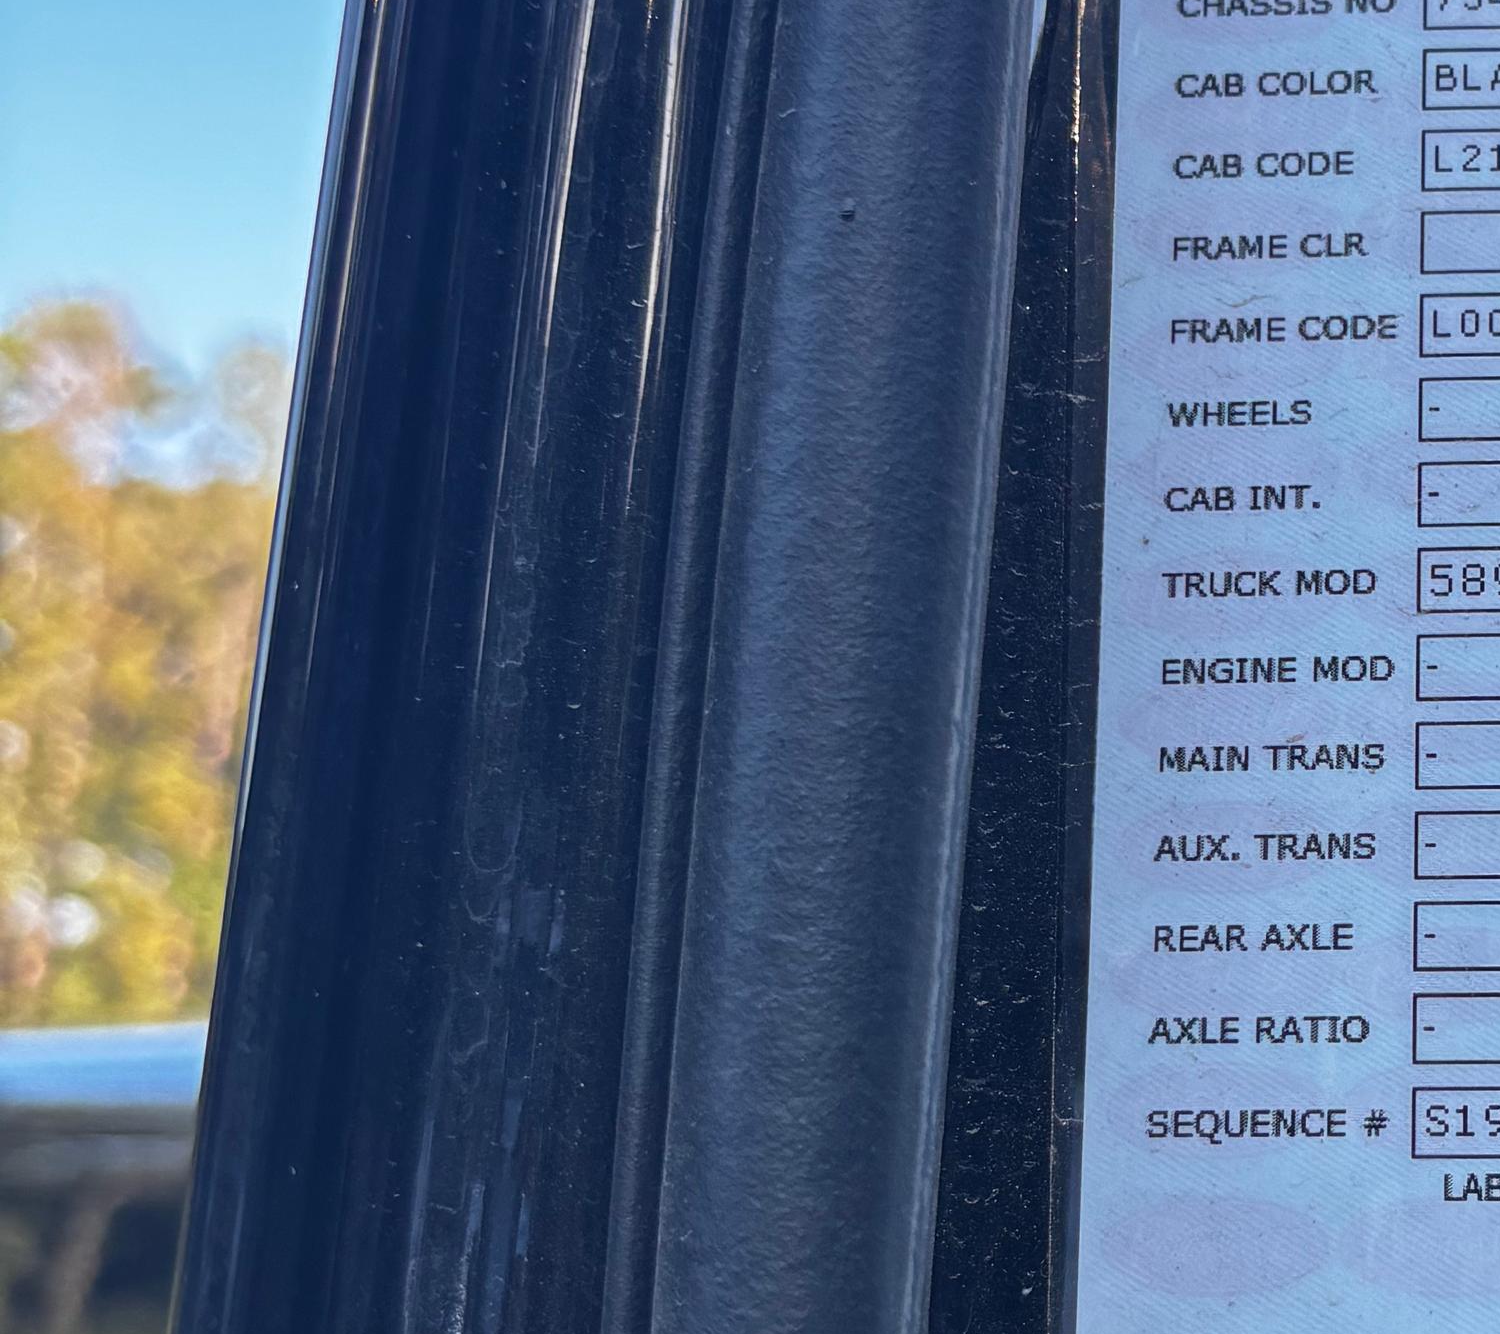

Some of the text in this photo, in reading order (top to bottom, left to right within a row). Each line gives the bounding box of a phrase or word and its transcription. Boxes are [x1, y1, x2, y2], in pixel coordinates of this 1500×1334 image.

[1175, 73, 1246, 98] CAB
[1258, 70, 1378, 96] COLOR
[1173, 154, 1244, 179] CAB
[1256, 151, 1354, 177] CODE
[1173, 233, 1369, 261] FRAME CLR
[1171, 317, 1285, 344] FRAME
[1298, 314, 1399, 341] CODE
[1167, 400, 1311, 427] WHEELS
[1164, 486, 1236, 512] CAB
[1250, 485, 1320, 510] INT.
[1162, 571, 1283, 598] TRUCK
[1296, 569, 1377, 595] MOD
[1162, 657, 1296, 684] ENGINE
[1314, 655, 1395, 682] MOD
[1160, 746, 1249, 772] MAIN
[1264, 744, 1385, 771] TRANS
[1154, 835, 1240, 861] AUX.
[1254, 833, 1376, 860] TRANS
[1154, 925, 1248, 952] REAR
[1261, 923, 1353, 951] AXLE
[1148, 1017, 1239, 1044] AXLE
[1256, 1016, 1370, 1043] RATIO
[1145, 1109, 1346, 1144] SEQUENCE
[1363, 1109, 1390, 1137] #
